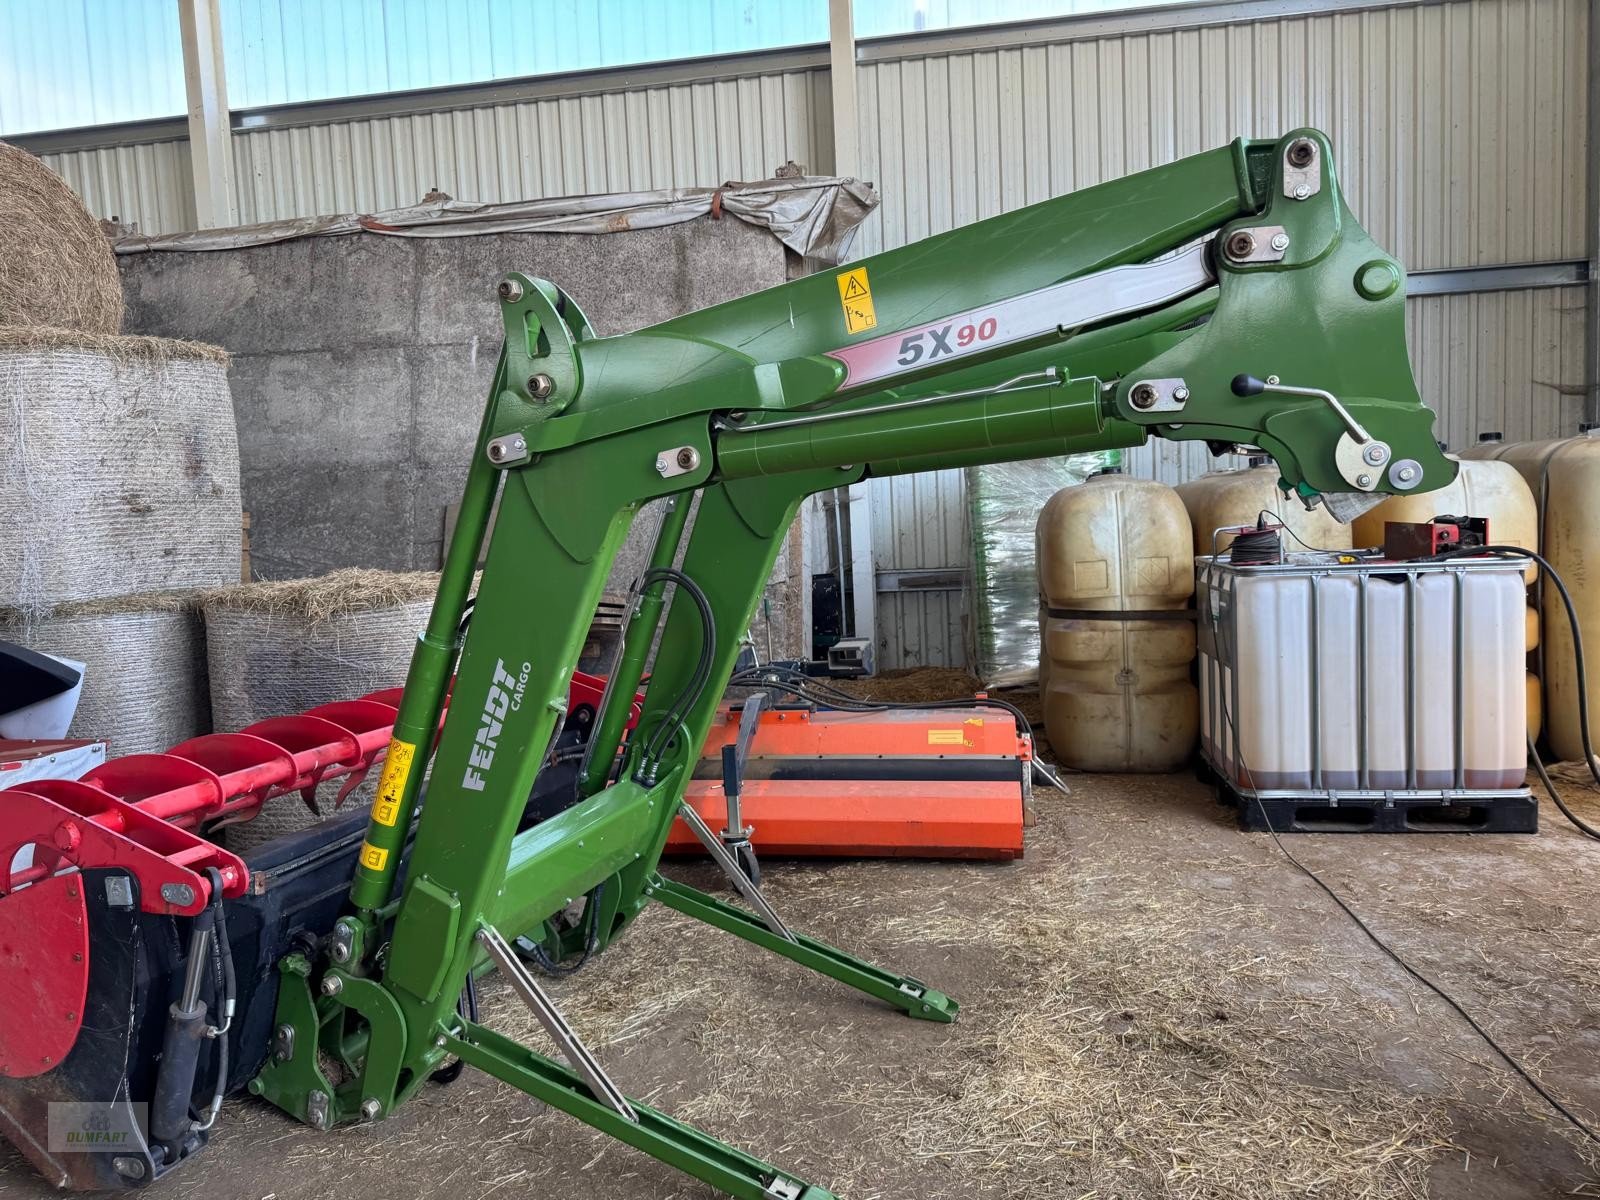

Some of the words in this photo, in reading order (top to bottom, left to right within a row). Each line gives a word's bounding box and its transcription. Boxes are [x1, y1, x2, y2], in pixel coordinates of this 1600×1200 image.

[897, 318, 997, 366] 5X90
[511, 662, 532, 712] CARGO
[462, 657, 516, 792] FENDT
